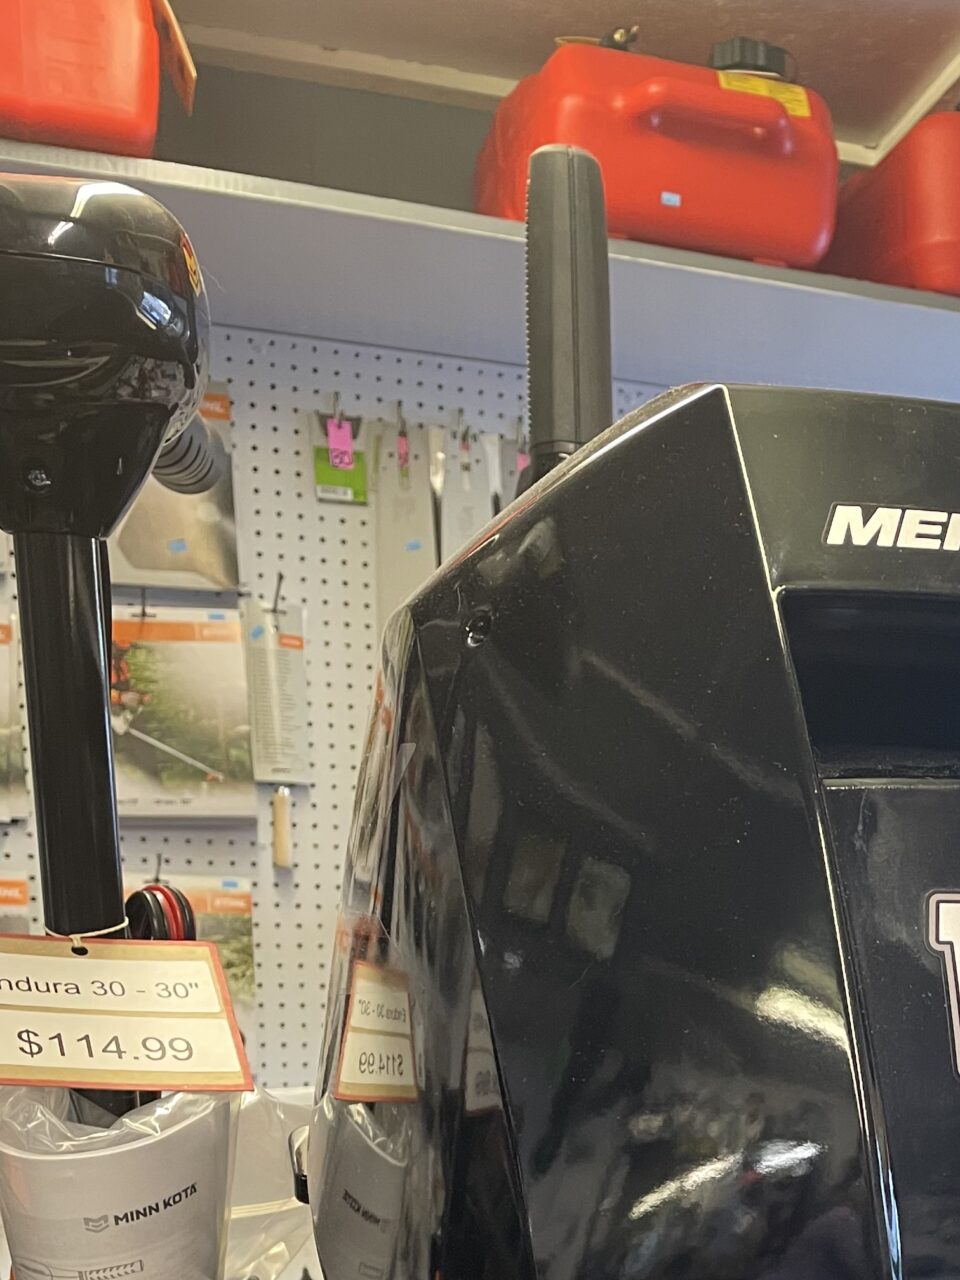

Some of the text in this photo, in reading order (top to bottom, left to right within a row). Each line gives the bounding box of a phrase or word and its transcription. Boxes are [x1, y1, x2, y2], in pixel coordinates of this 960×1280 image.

[0, 976, 81, 995] ndura
[90, 980, 126, 997] 30
[154, 982, 199, 999] 30"
[17, 1029, 194, 1061] $114.99
[113, 1182, 198, 1226] MINN KOTA
